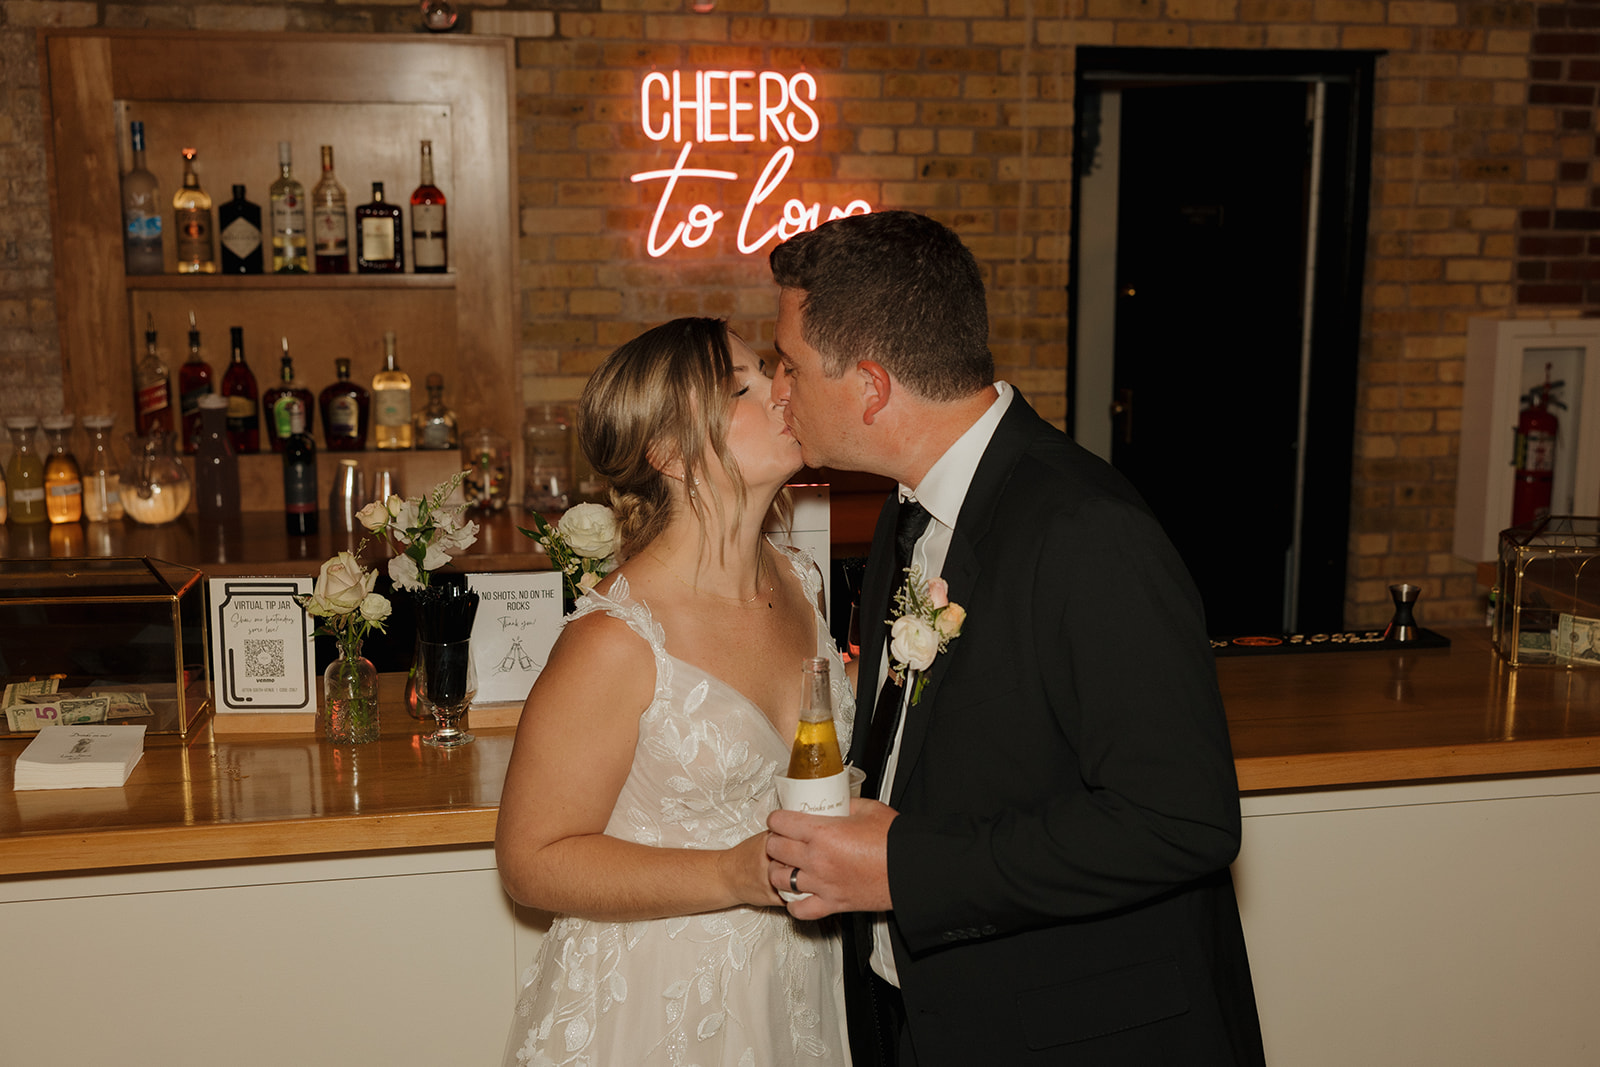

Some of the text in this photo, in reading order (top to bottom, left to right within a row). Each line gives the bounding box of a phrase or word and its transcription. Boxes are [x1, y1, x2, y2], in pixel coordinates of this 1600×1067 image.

[641, 69, 819, 143] CHEERS
[630, 141, 872, 257] to lov
[481, 589, 555, 601] NO SHOTS, NO ON THE
[233, 600, 291, 610] VIRTUAL TIP JAR
[506, 601, 531, 611] ROCKS
[496, 616, 518, 631] Thank
[35, 706, 58, 720] 5
